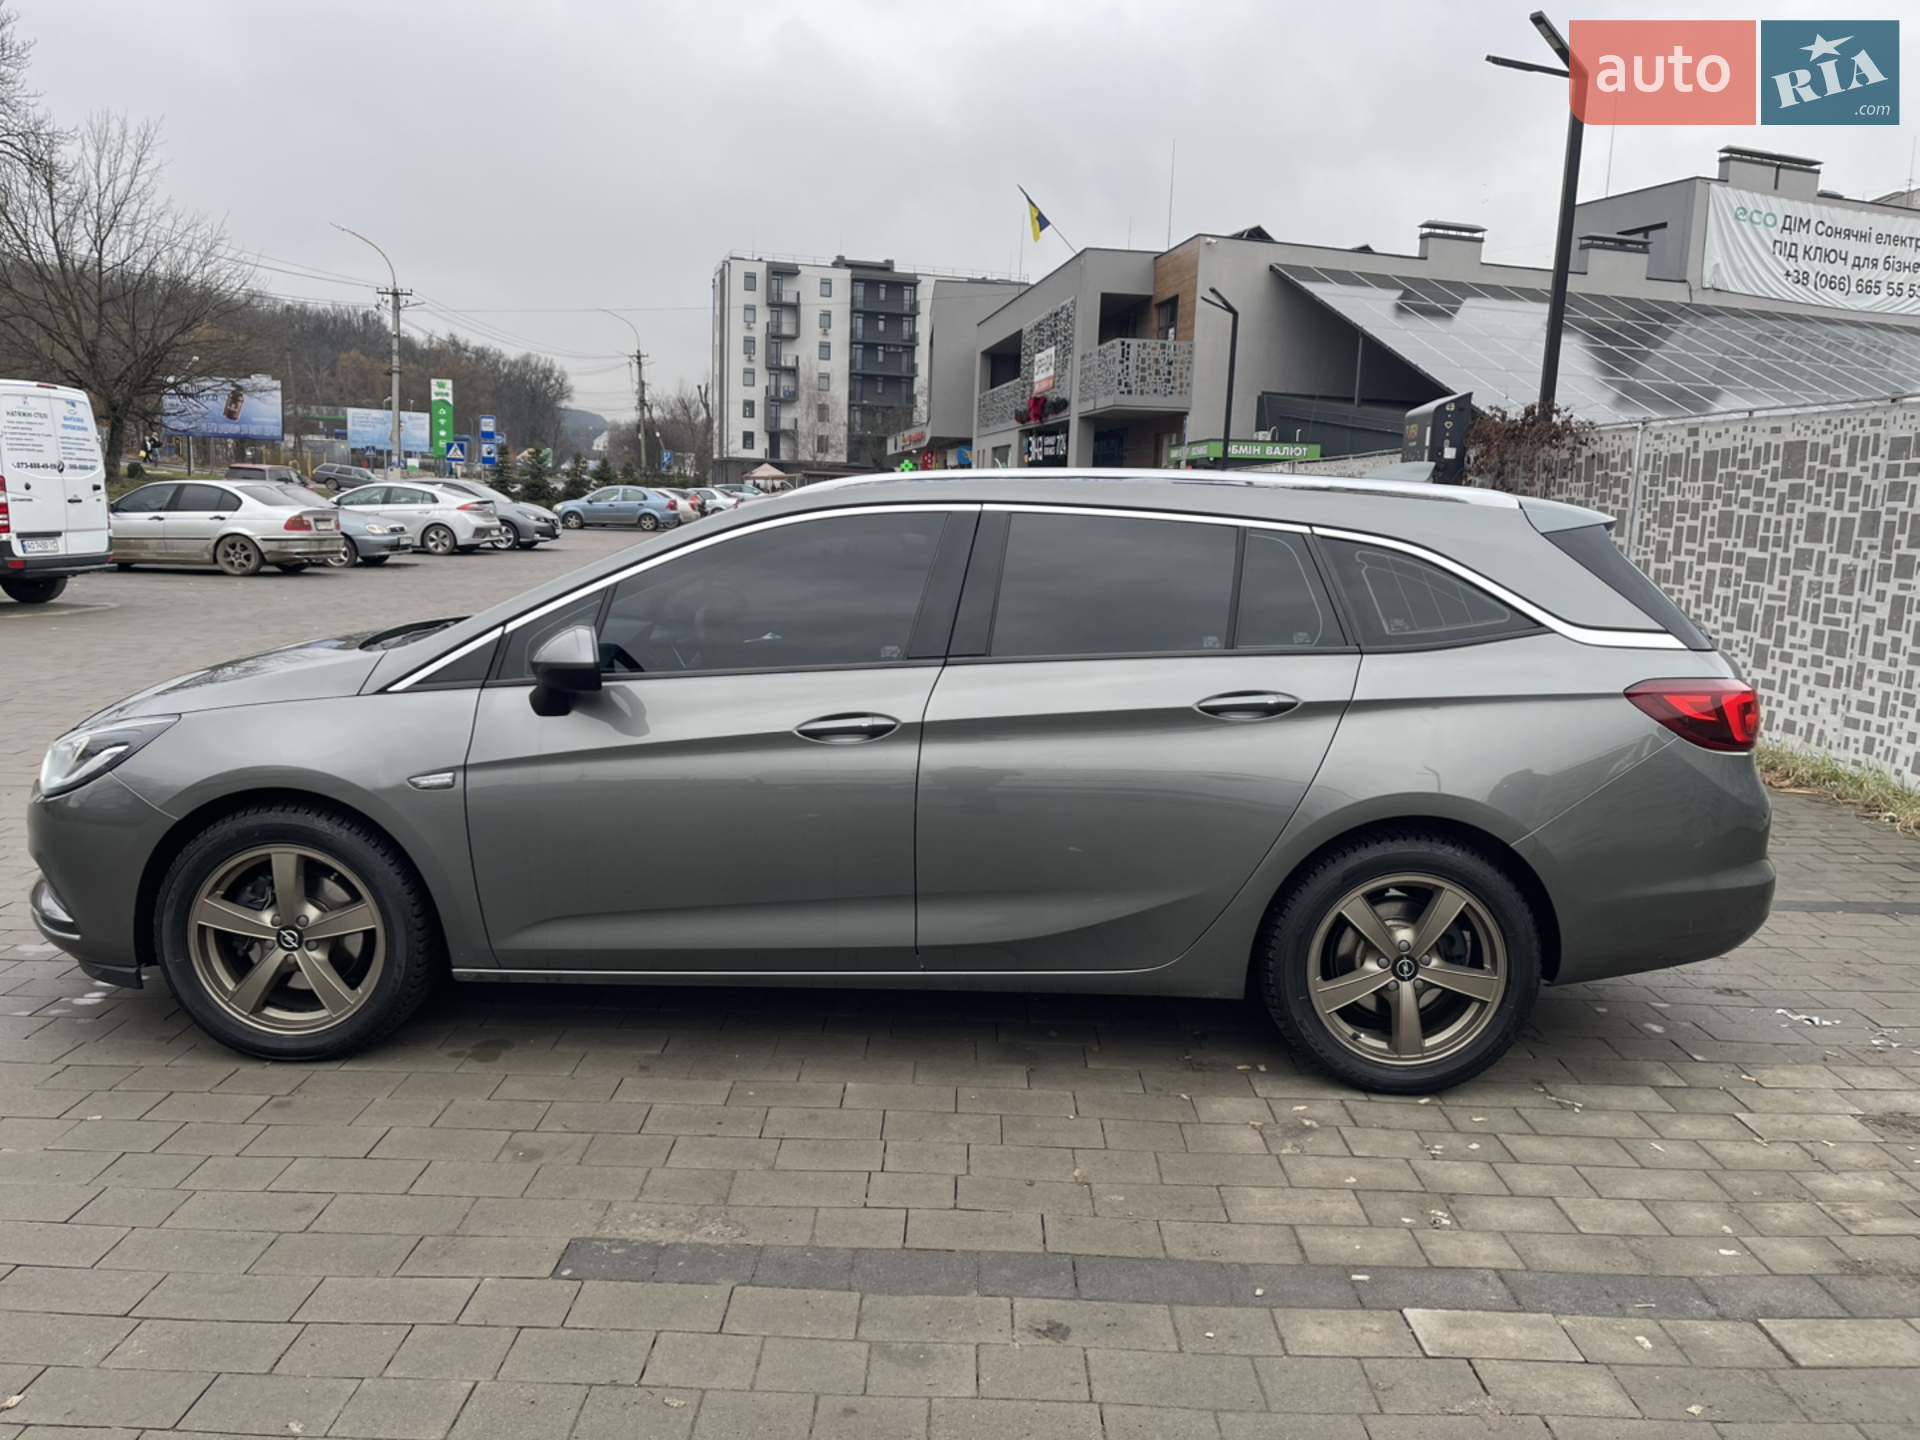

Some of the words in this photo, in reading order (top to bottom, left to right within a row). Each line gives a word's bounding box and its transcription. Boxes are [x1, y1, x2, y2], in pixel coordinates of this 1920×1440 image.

[1780, 214, 1811, 235] ДІМ
[1815, 220, 1873, 243] Сонячні
[1772, 240, 1798, 263] ПІД
[1802, 245, 1848, 266] КЛЮЧ
[1851, 255, 1879, 271] для
[1883, 255, 1920, 274] бізне
[1784, 269, 1810, 286] +38
[1814, 271, 1851, 296] (066)
[1856, 278, 1882, 295] 665
[1886, 282, 1904, 297] 55
[1265, 446, 1309, 457] ВАЛЮТ
